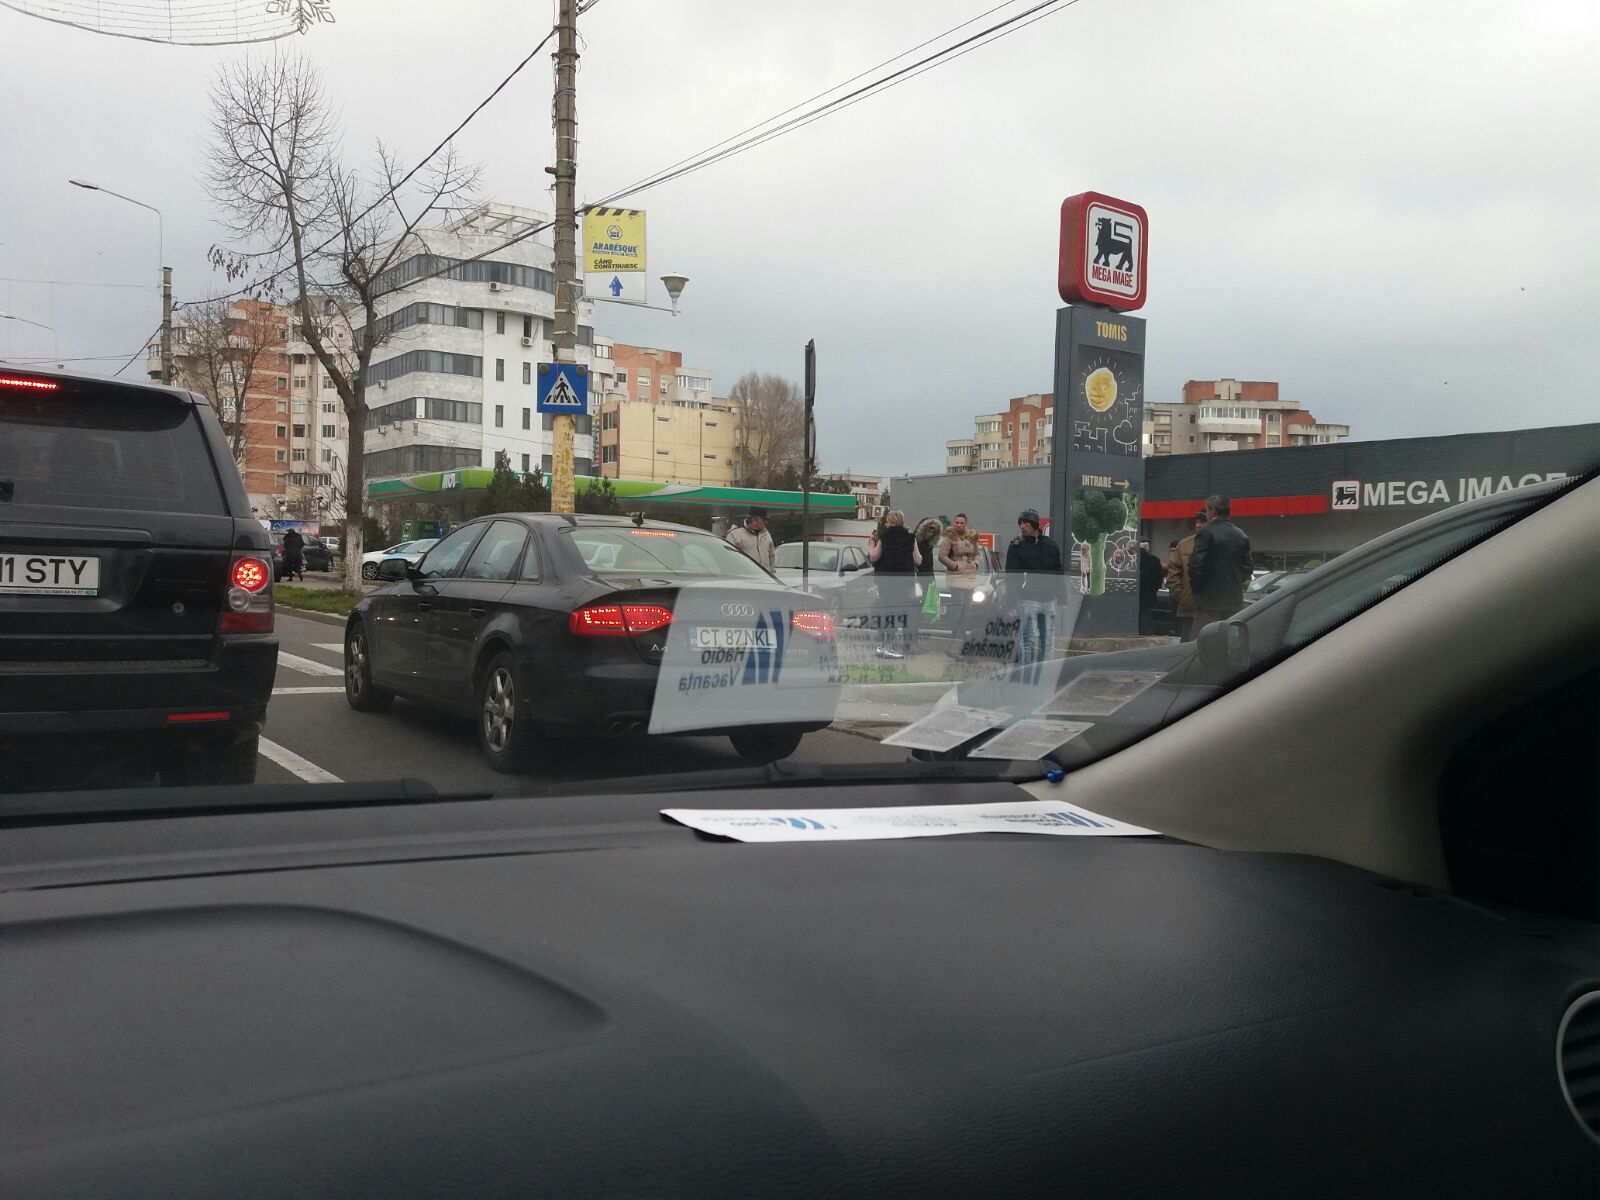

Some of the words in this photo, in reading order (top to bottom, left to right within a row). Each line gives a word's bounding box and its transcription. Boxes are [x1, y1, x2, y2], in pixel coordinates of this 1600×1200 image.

[593, 243, 638, 253] ARABESQUE
[1092, 264, 1111, 282] MEGA
[1112, 270, 1133, 288] IMAGE
[1095, 320, 1128, 342] TOMIS
[1082, 473, 1112, 489] INTRARE
[1363, 479, 1451, 506] MEGA
[1458, 472, 1567, 503] IMA
[25, 557, 88, 585] STY
[699, 628, 719, 645] CT
